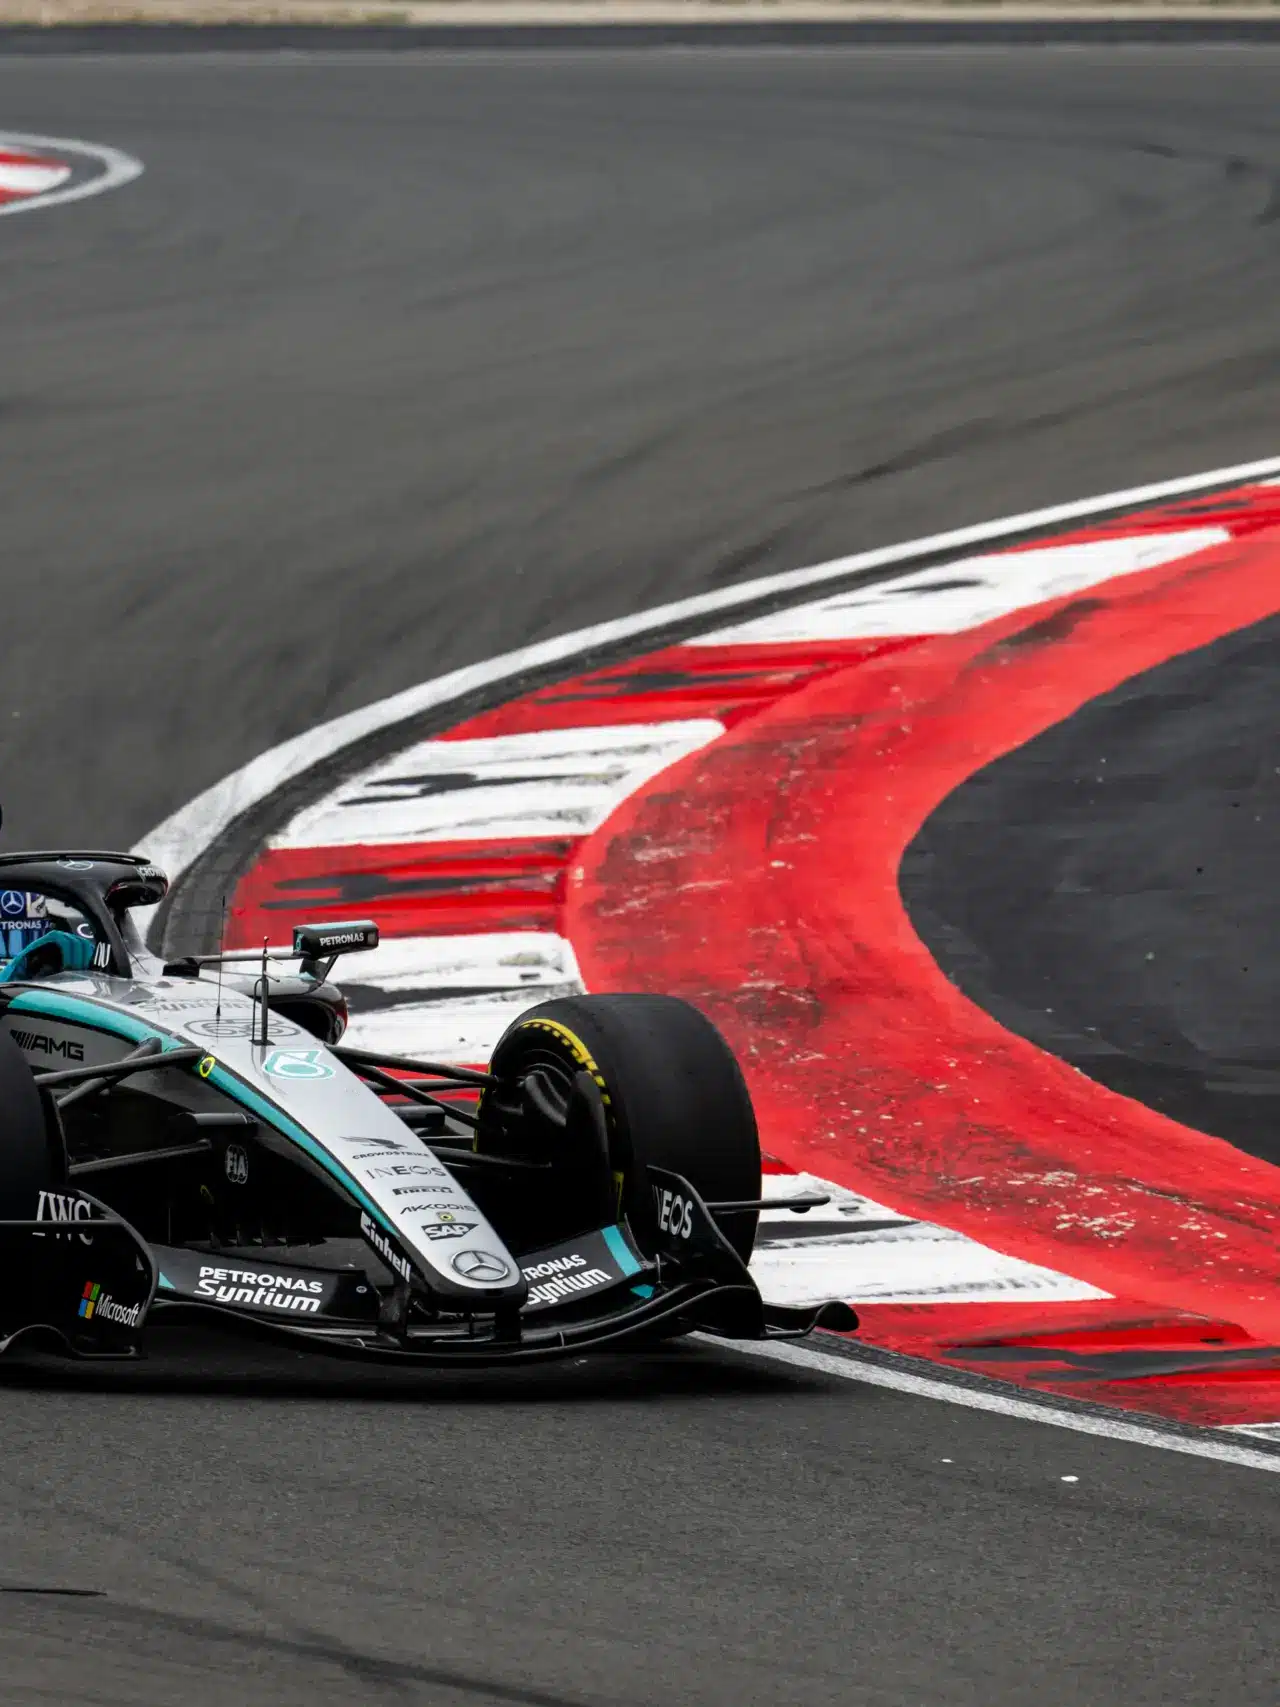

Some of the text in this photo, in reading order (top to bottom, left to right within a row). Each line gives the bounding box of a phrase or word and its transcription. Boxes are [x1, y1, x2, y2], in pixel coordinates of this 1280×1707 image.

[320, 932, 364, 947] PETRONAS
[30, 1034, 84, 1062] AMG
[364, 1165, 447, 1180] INEOS
[31, 1190, 94, 1246] IWC
[423, 1224, 476, 1239] SAP
[199, 1266, 324, 1294] PETRONAS
[95, 1292, 141, 1327] Microsoft
[191, 1279, 322, 1313] Syntium
